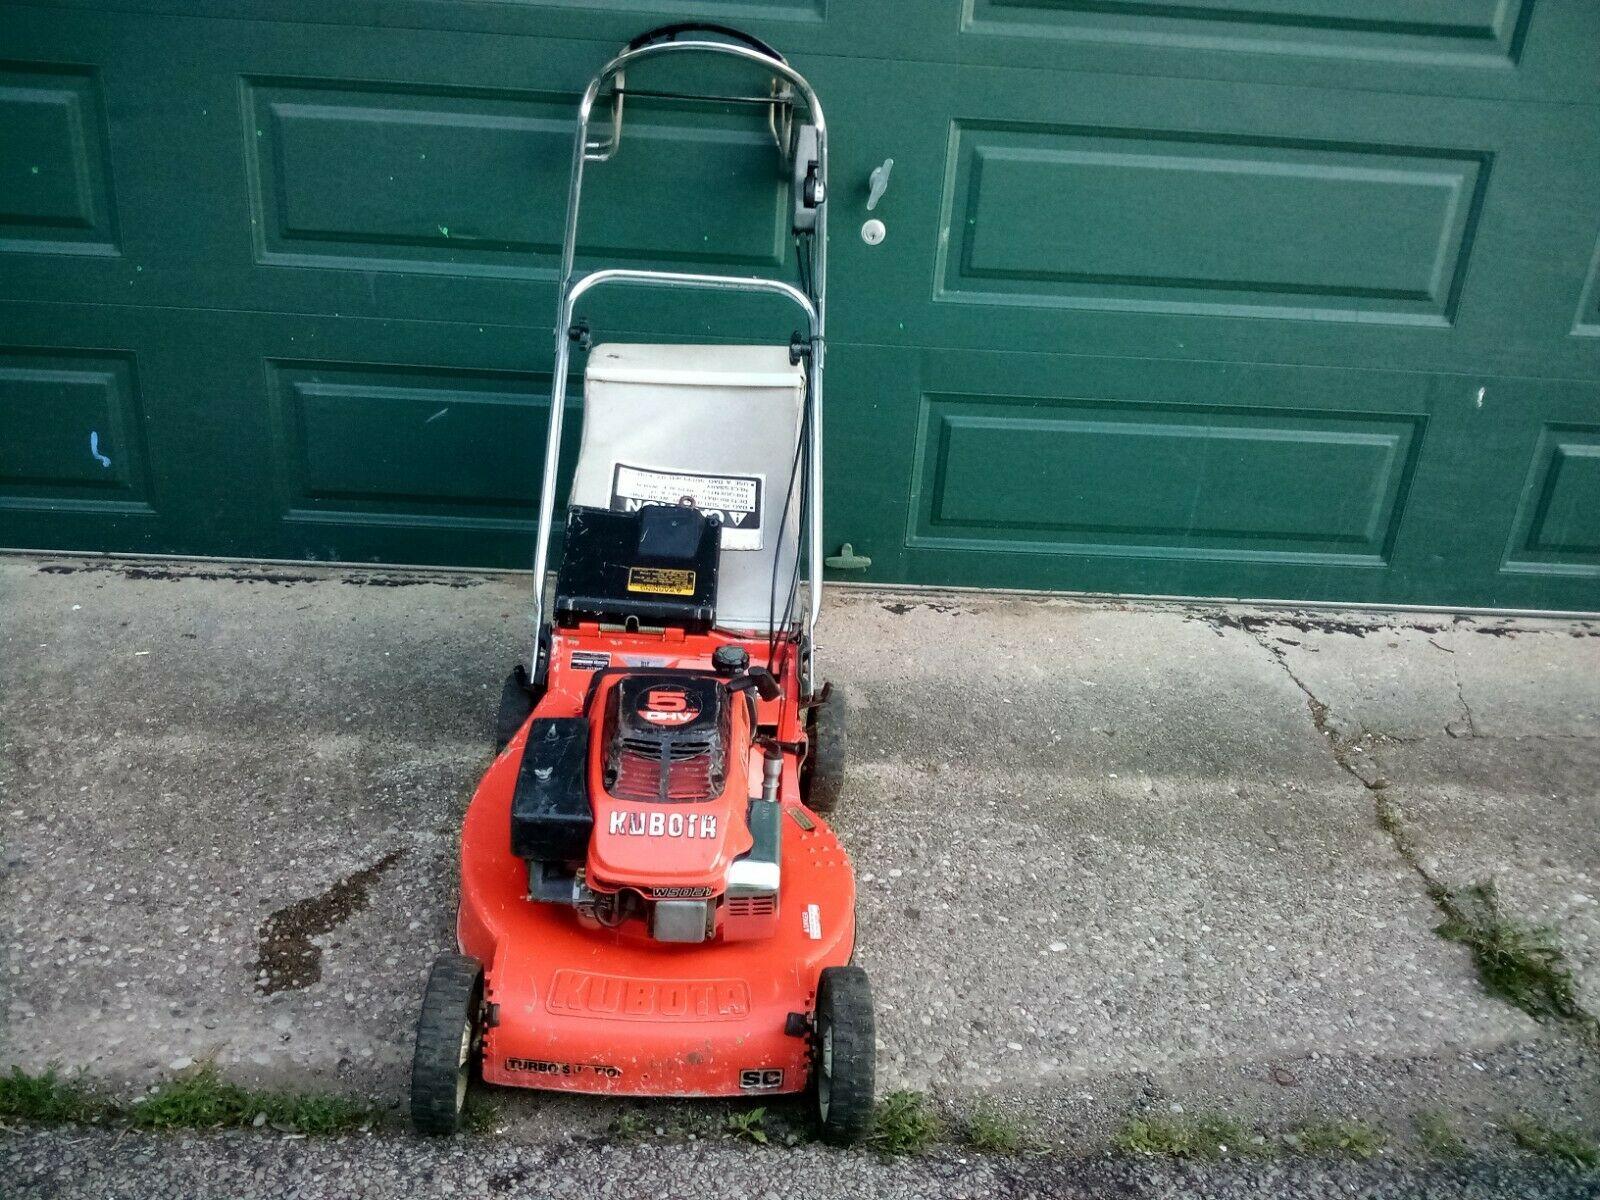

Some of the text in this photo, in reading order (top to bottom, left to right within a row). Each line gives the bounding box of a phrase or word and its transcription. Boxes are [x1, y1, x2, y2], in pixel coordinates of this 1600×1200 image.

[647, 690, 687, 712] 5
[608, 811, 718, 839] KUBOTA
[551, 973, 747, 1017] KUBOTA
[508, 1060, 556, 1074] TURBO
[741, 1069, 782, 1086] SC
